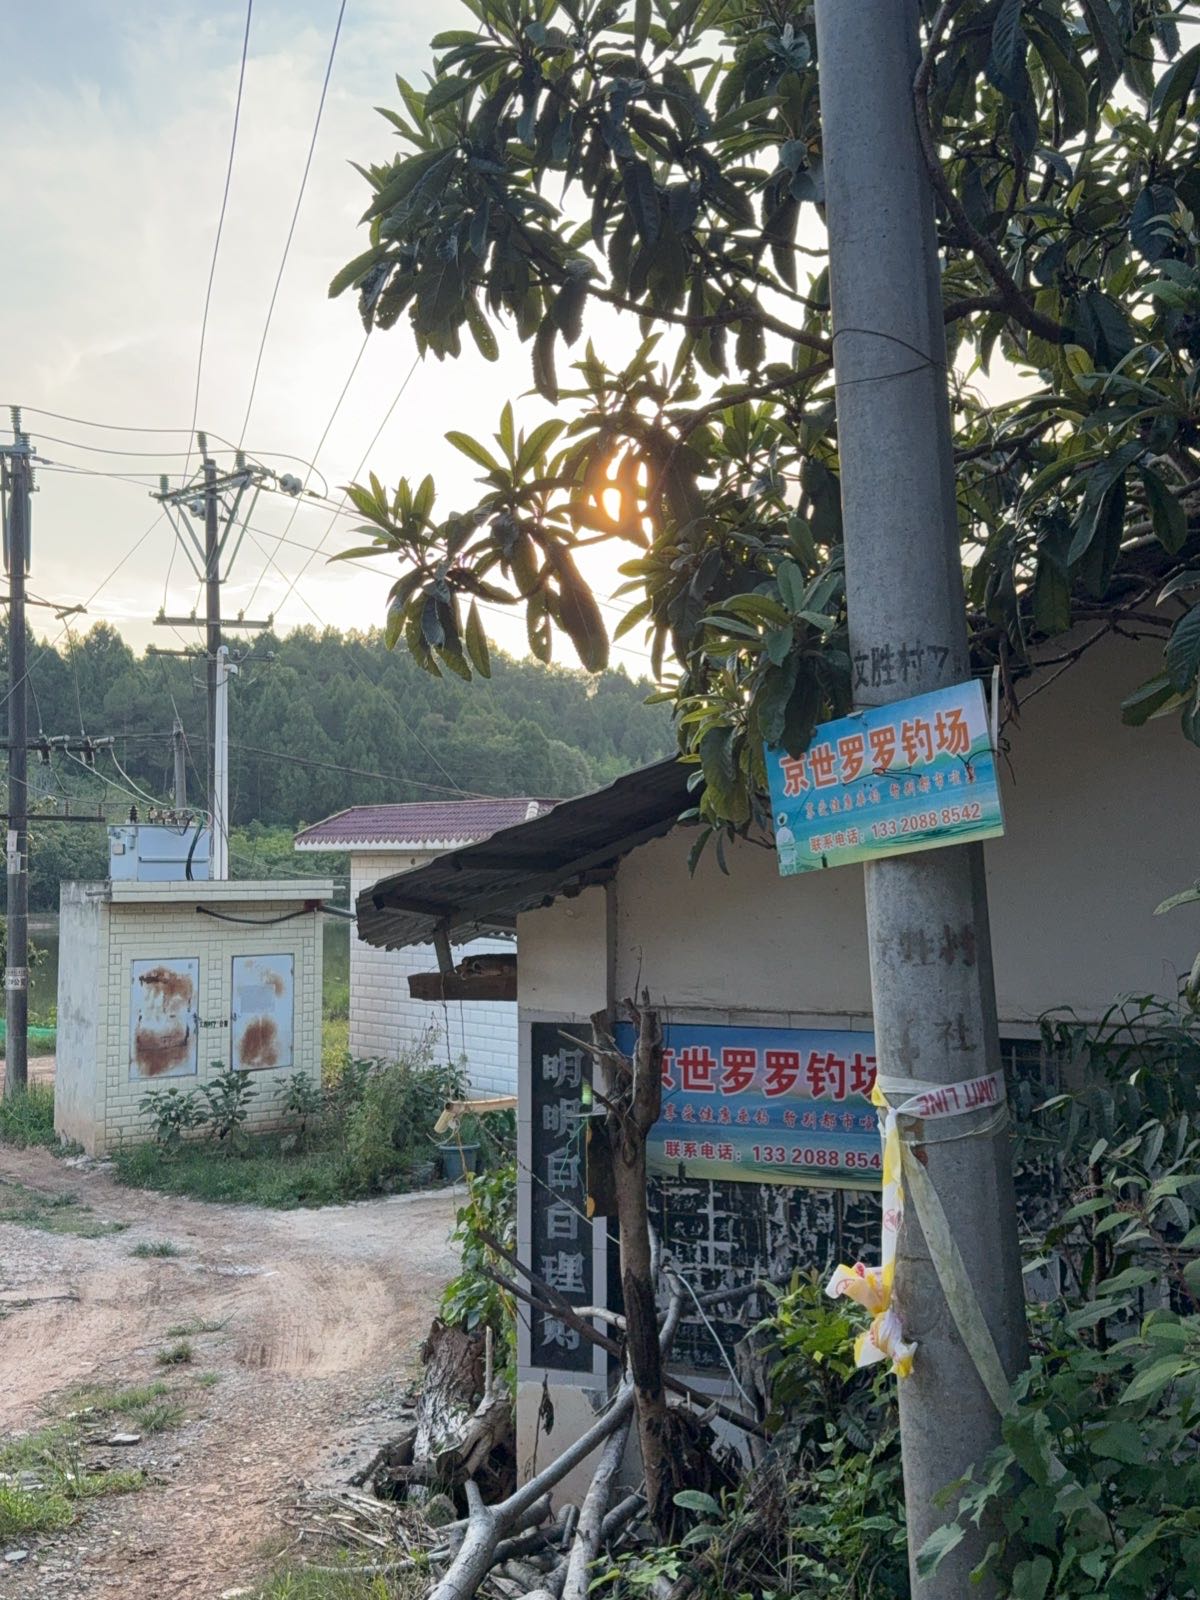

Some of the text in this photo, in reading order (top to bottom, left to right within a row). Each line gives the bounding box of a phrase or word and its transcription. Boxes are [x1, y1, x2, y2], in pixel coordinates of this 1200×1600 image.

[779, 708, 972, 797] 京世罗罗钓场
[871, 821, 897, 839] 133
[901, 812, 938, 833] 2088
[941, 802, 982, 824] 8542
[916, 1087, 960, 1116] LINE
[752, 1146, 786, 1163] 133
[791, 1148, 840, 1167] 2088
